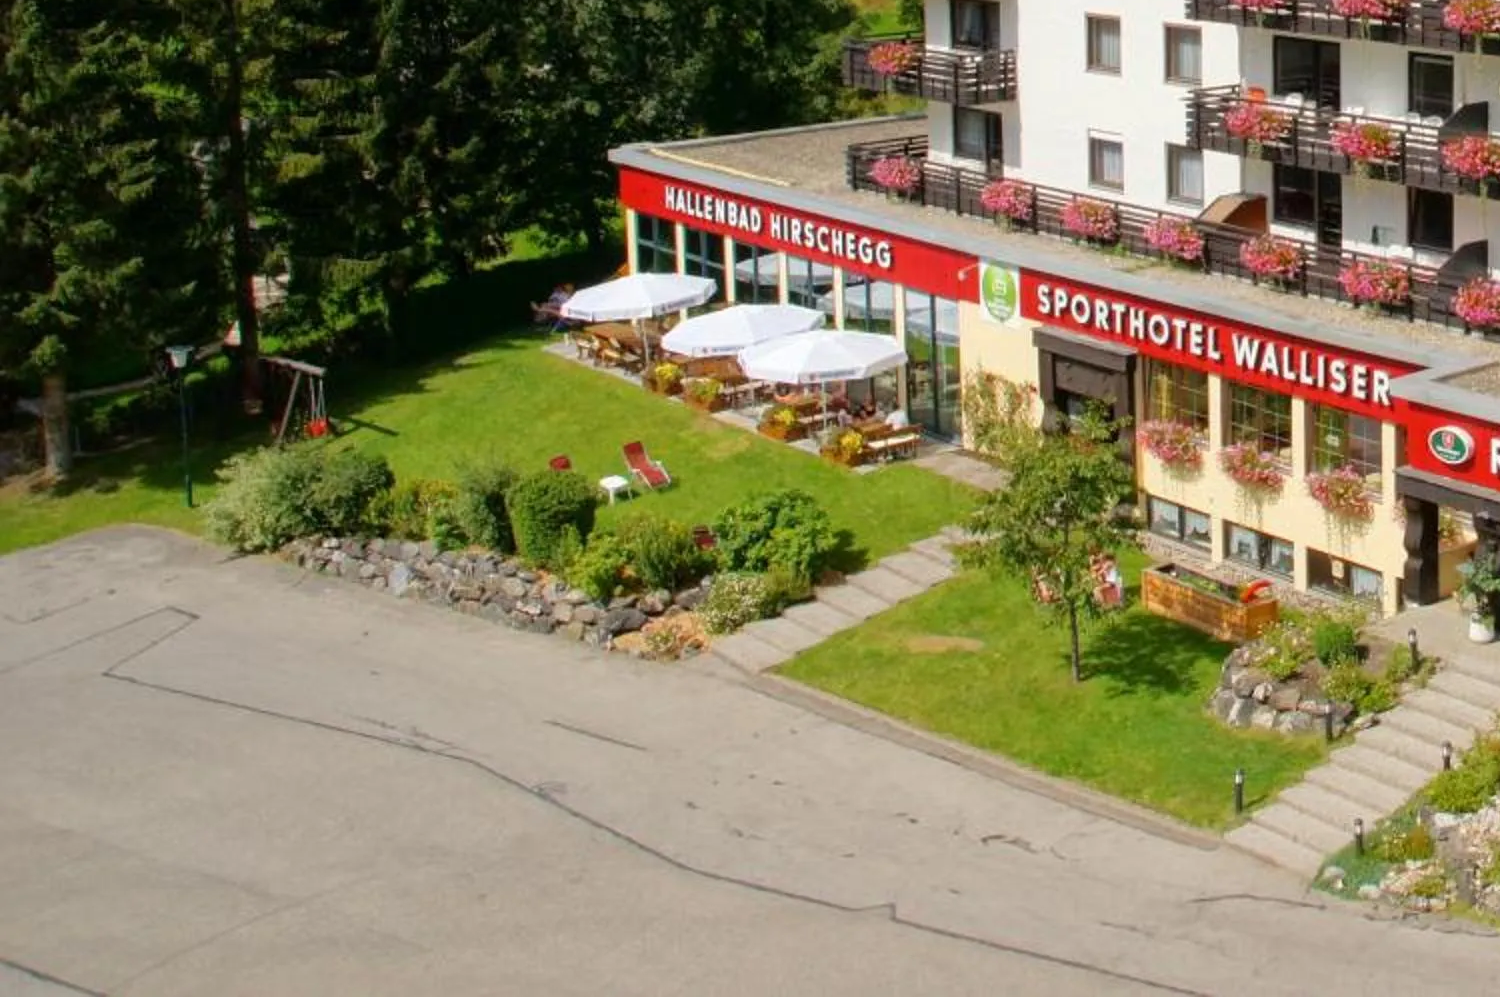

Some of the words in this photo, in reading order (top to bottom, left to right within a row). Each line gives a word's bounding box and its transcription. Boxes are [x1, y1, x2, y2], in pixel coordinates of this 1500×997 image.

[665, 185, 762, 234] HALLENBAD
[770, 213, 892, 269] HIRSCHEGG
[1036, 283, 1221, 361] SPORTHOTEL
[1231, 333, 1393, 407] WALLISER
